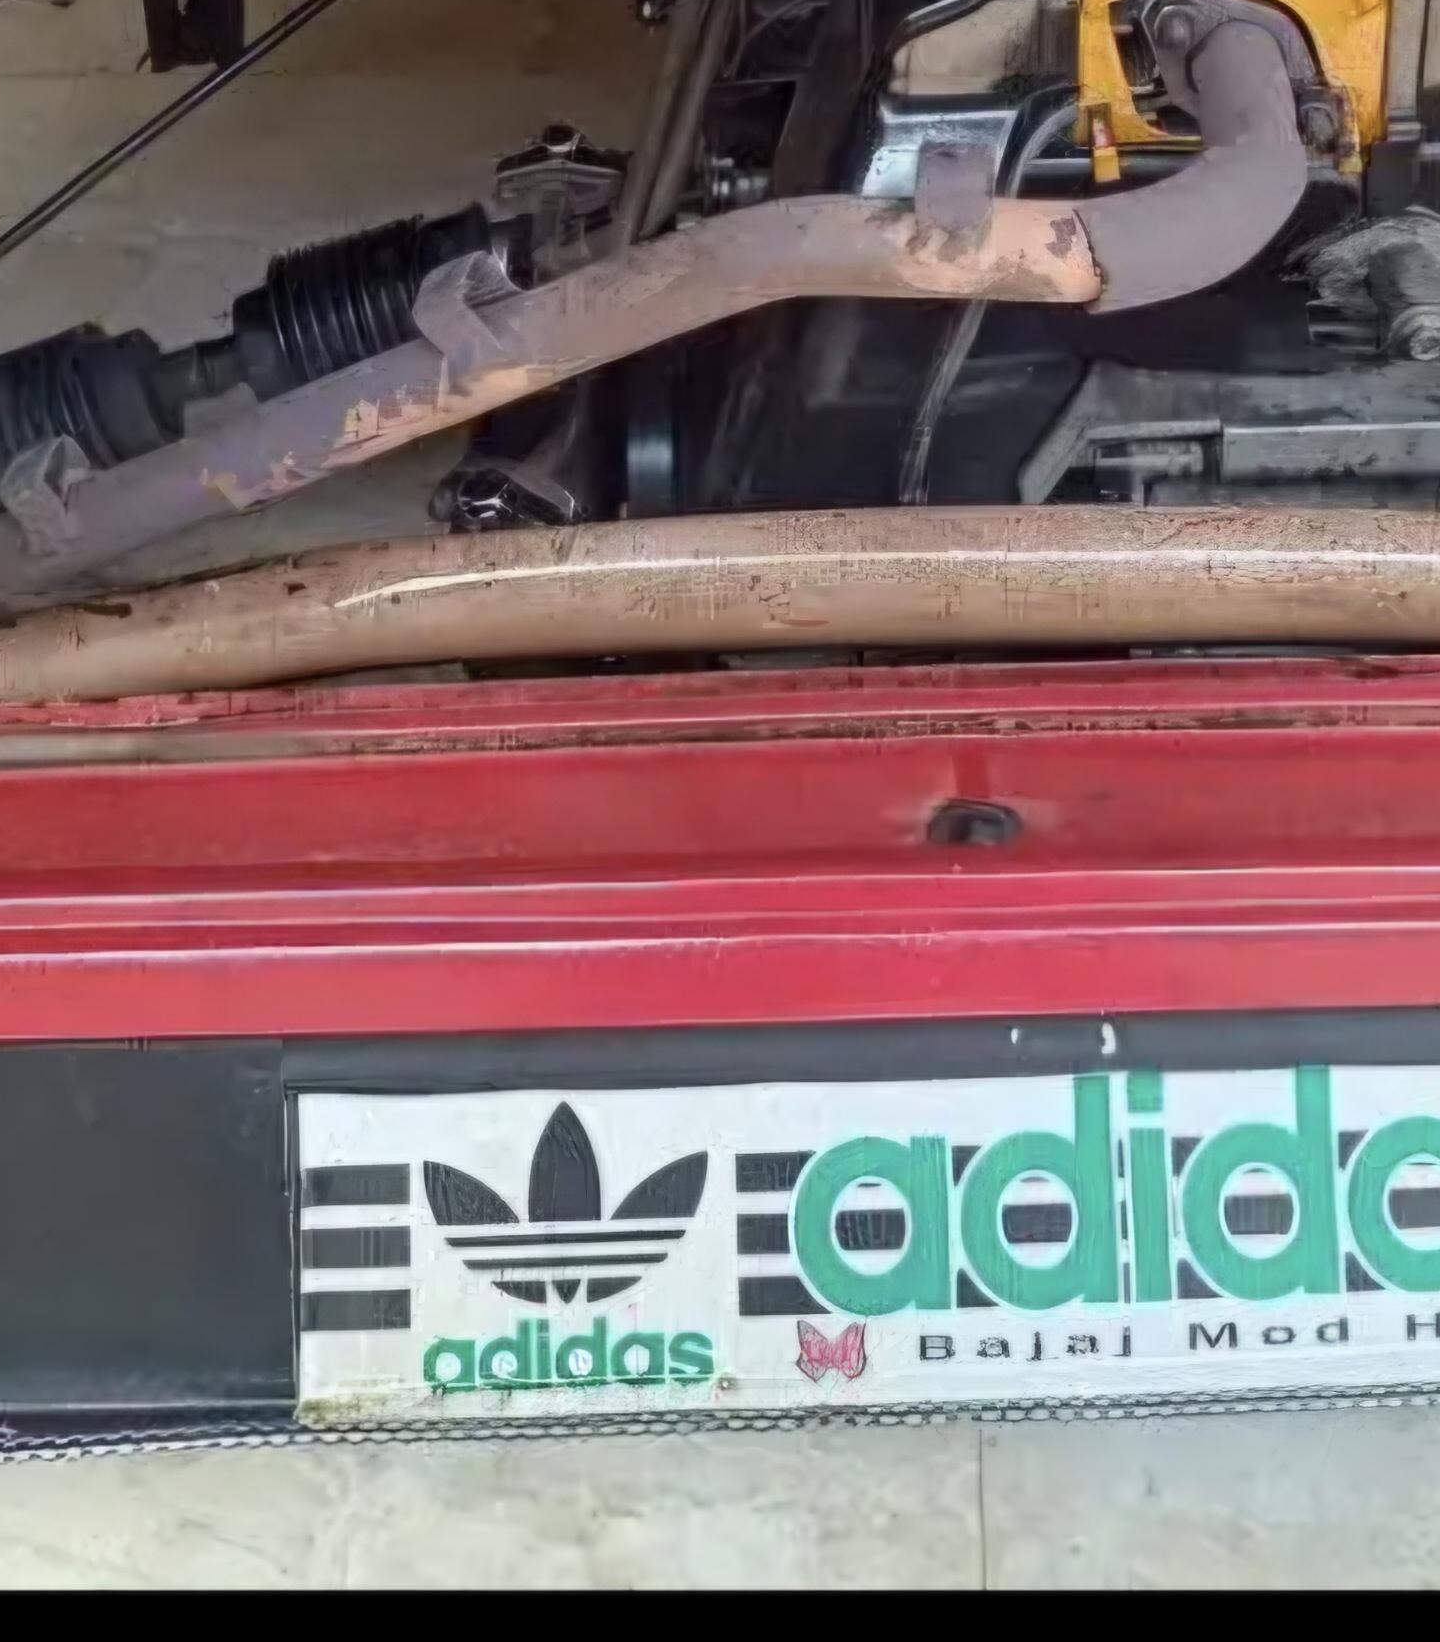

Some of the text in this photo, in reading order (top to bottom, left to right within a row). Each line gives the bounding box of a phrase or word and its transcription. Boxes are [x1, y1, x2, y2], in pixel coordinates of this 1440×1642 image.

[422, 1315, 716, 1392] adidas
[918, 1325, 1133, 1361] Bajaj
[1188, 1316, 1349, 1351] Mod
